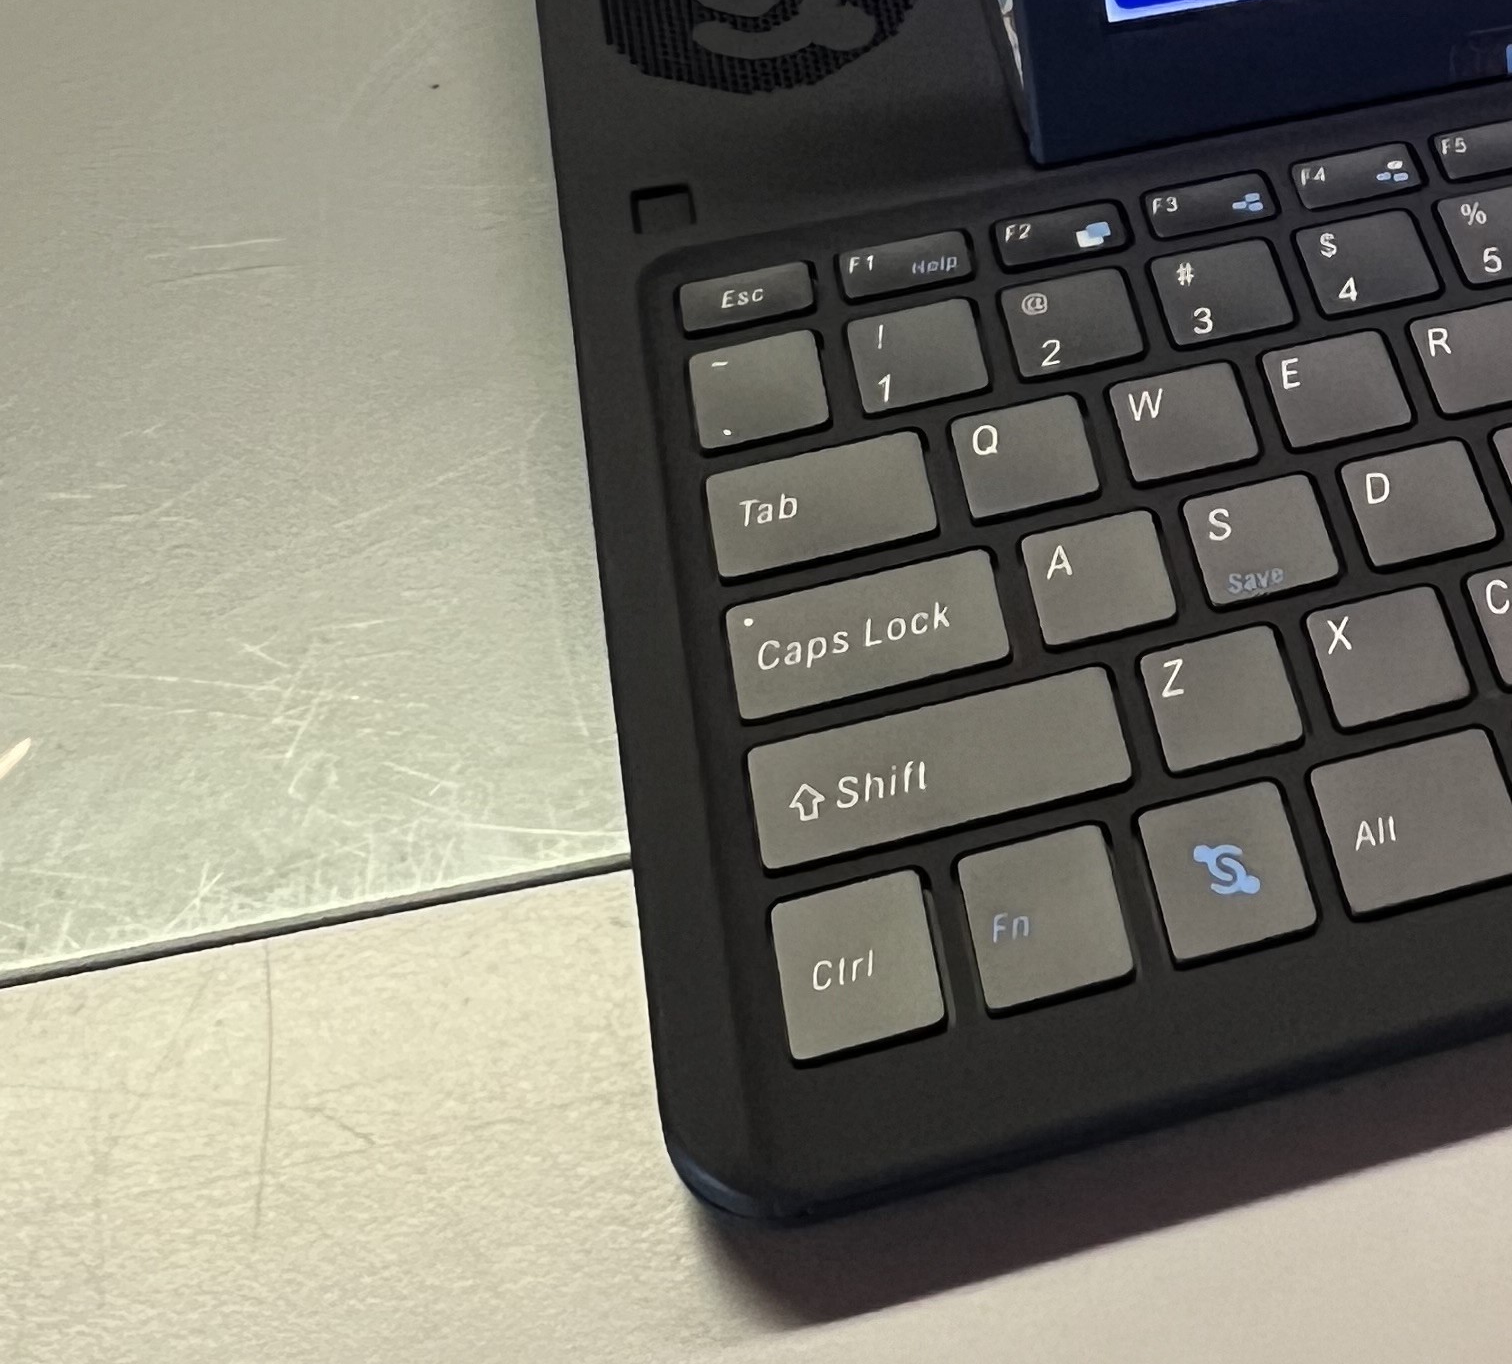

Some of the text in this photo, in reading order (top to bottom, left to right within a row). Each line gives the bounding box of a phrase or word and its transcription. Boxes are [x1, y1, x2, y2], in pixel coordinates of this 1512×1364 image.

[1440, 137, 1467, 155] F5
[1300, 166, 1326, 186] F4
[1151, 196, 1179, 215] F3
[1460, 201, 1488, 226] %
[1004, 223, 1032, 243] F2
[848, 254, 958, 276] F1 Help
[1176, 261, 1195, 286] #
[1482, 246, 1503, 274] 5
[720, 287, 765, 310] Esc
[1020, 292, 1049, 316] @
[1338, 276, 1358, 302] 4
[1193, 306, 1214, 335] 3
[1040, 338, 1061, 367] 2
[1427, 326, 1453, 357] R
[878, 373, 892, 402] 1
[1280, 356, 1302, 389] E
[1127, 387, 1164, 422] W
[971, 423, 999, 456] Q
[1365, 471, 1391, 505] D
[738, 492, 798, 528] Tab
[1207, 507, 1233, 541] S
[1045, 544, 1074, 580] A
[1226, 566, 1285, 595] Save
[1484, 579, 1511, 615] C
[756, 601, 952, 672] Caps Lock
[1325, 615, 1353, 656] X
[1160, 657, 1185, 699] Z
[834, 759, 928, 810] Shift
[991, 912, 1032, 944] Fn
[811, 948, 875, 992] Ctrl
